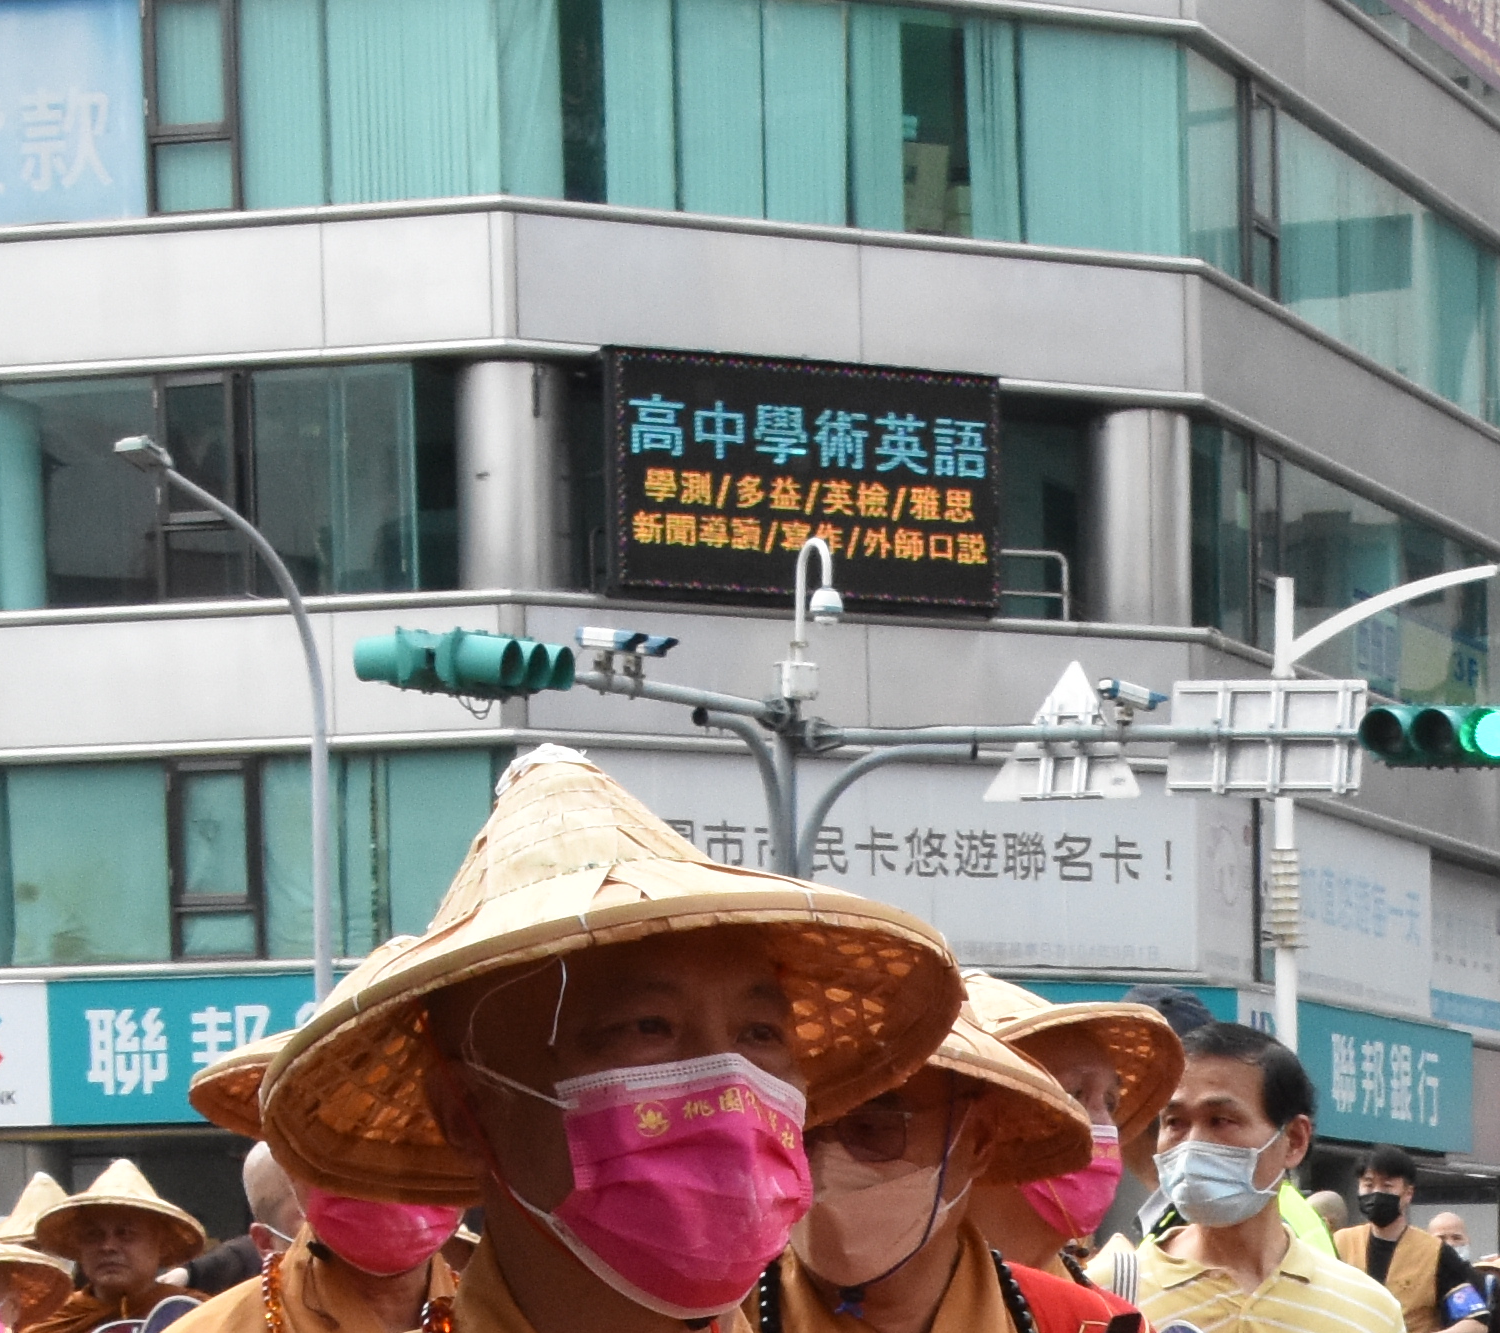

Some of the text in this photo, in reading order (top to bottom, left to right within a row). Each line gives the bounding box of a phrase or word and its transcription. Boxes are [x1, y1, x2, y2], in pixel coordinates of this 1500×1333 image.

[628, 393, 989, 479] 高中學術英語
[644, 467, 975, 523] 學測/多益/英檢/雅思
[85, 1003, 315, 1095] 聯邦
[1331, 1033, 1439, 1127] 聯邦銀行
